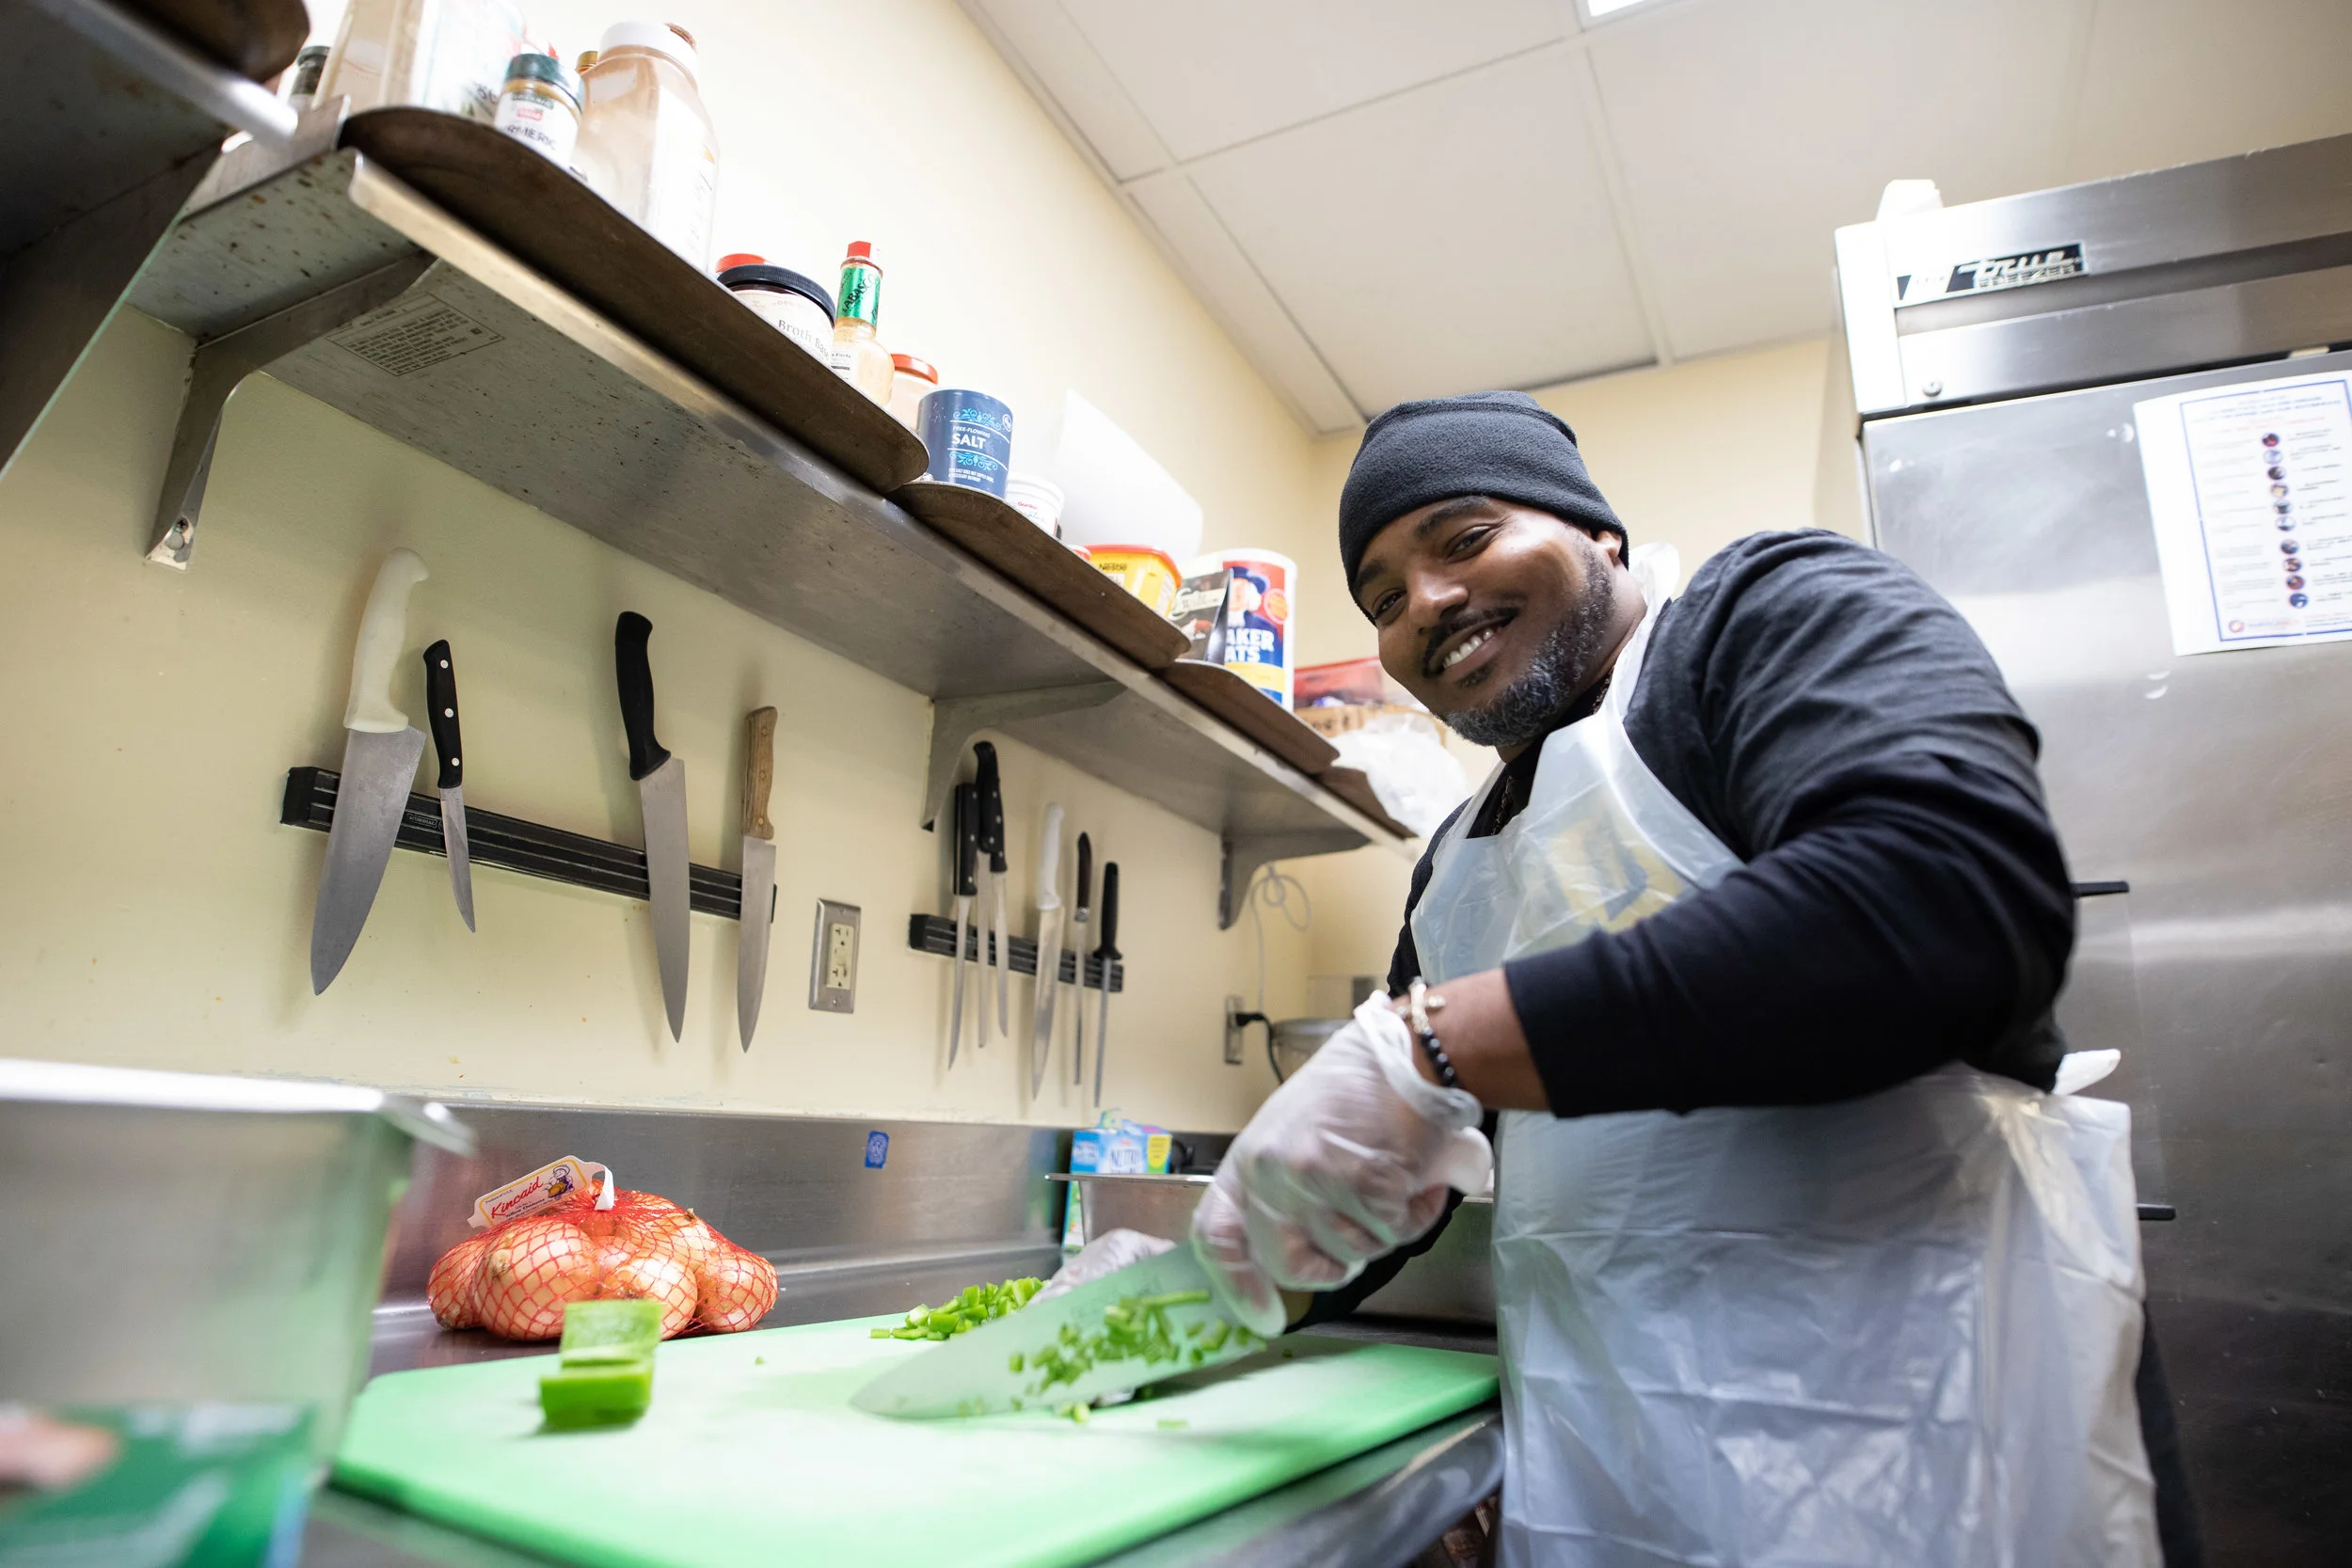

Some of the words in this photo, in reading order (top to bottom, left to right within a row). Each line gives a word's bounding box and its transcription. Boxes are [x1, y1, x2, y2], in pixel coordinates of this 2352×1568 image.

[778, 319, 812, 342] Broth
[951, 433, 987, 450] SALT
[1227, 628, 1275, 652] AKER
[1224, 645, 1261, 662] ATS
[490, 1176, 544, 1219] Kincaid
